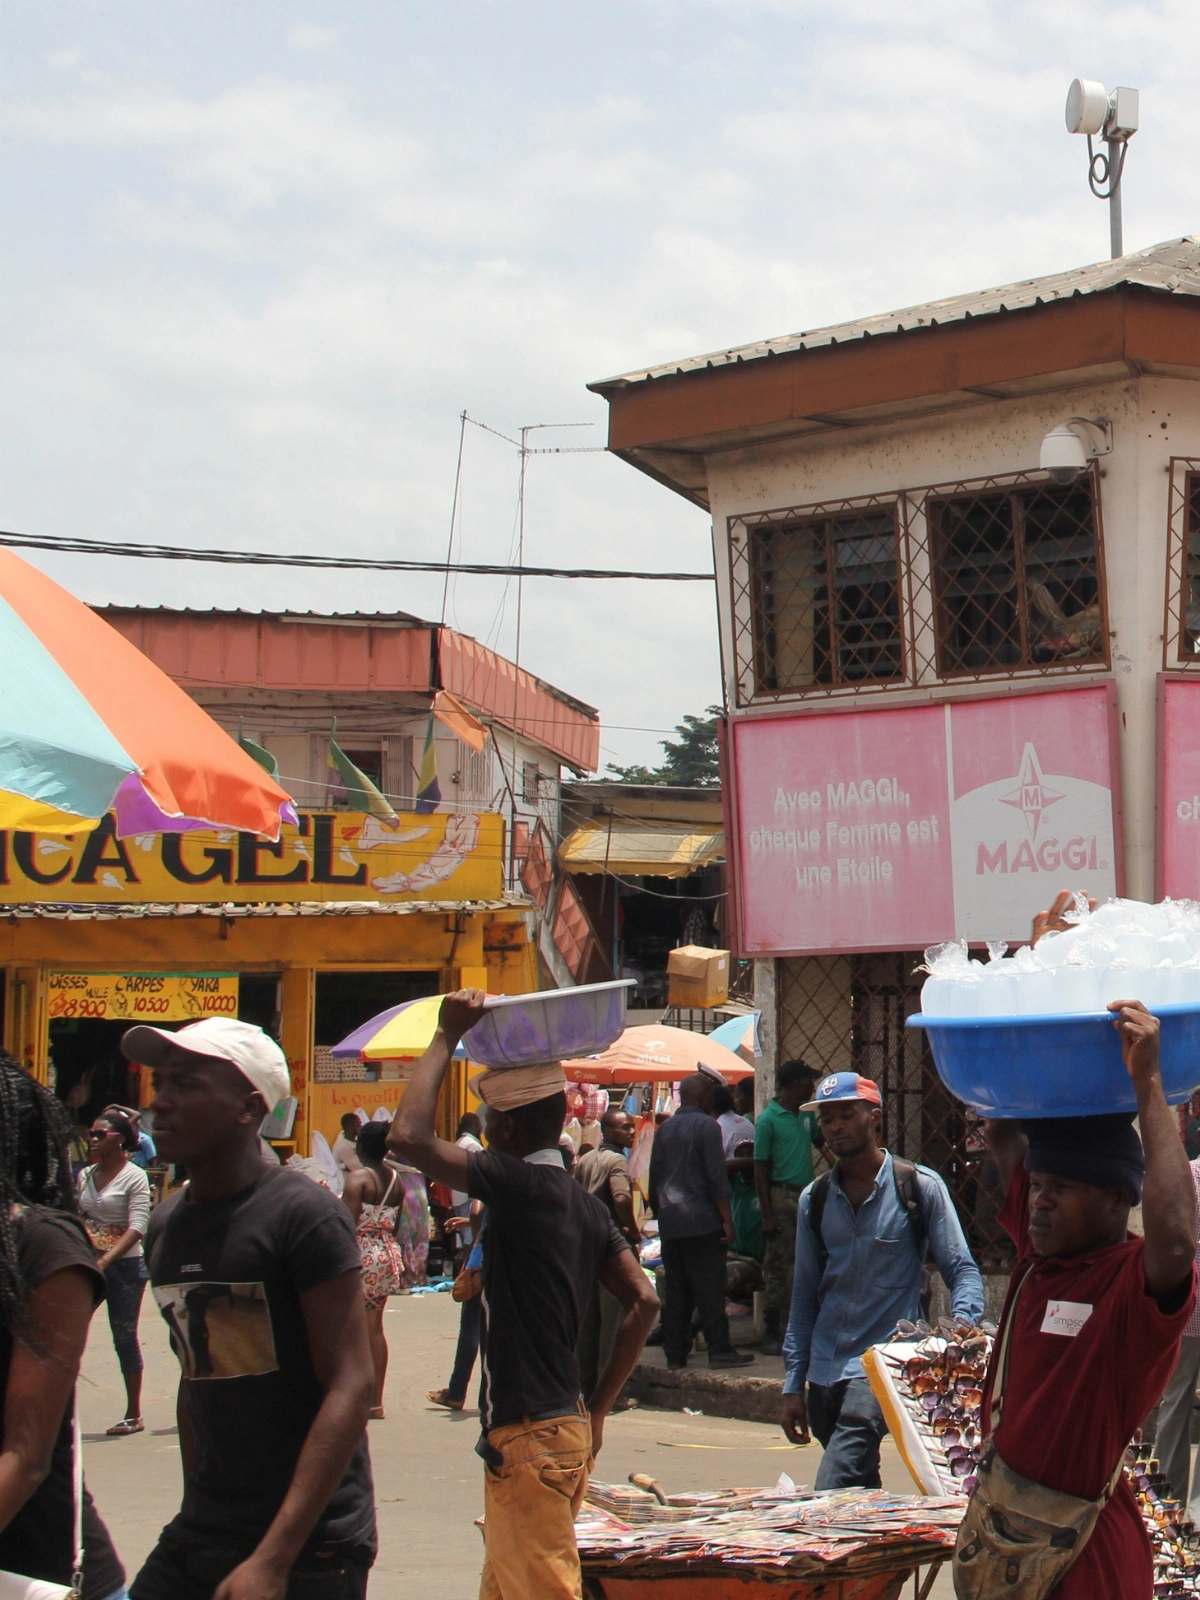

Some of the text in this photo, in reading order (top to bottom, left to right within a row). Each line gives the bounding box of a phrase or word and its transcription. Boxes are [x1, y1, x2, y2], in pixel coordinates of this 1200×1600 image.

[774, 787, 821, 809] Avec
[750, 815, 939, 854] chaque Femme est
[161, 814, 367, 886] GEL
[796, 856, 893, 885] une Etoile
[115, 976, 165, 993] CARPES
[636, 1052, 672, 1064] airtel
